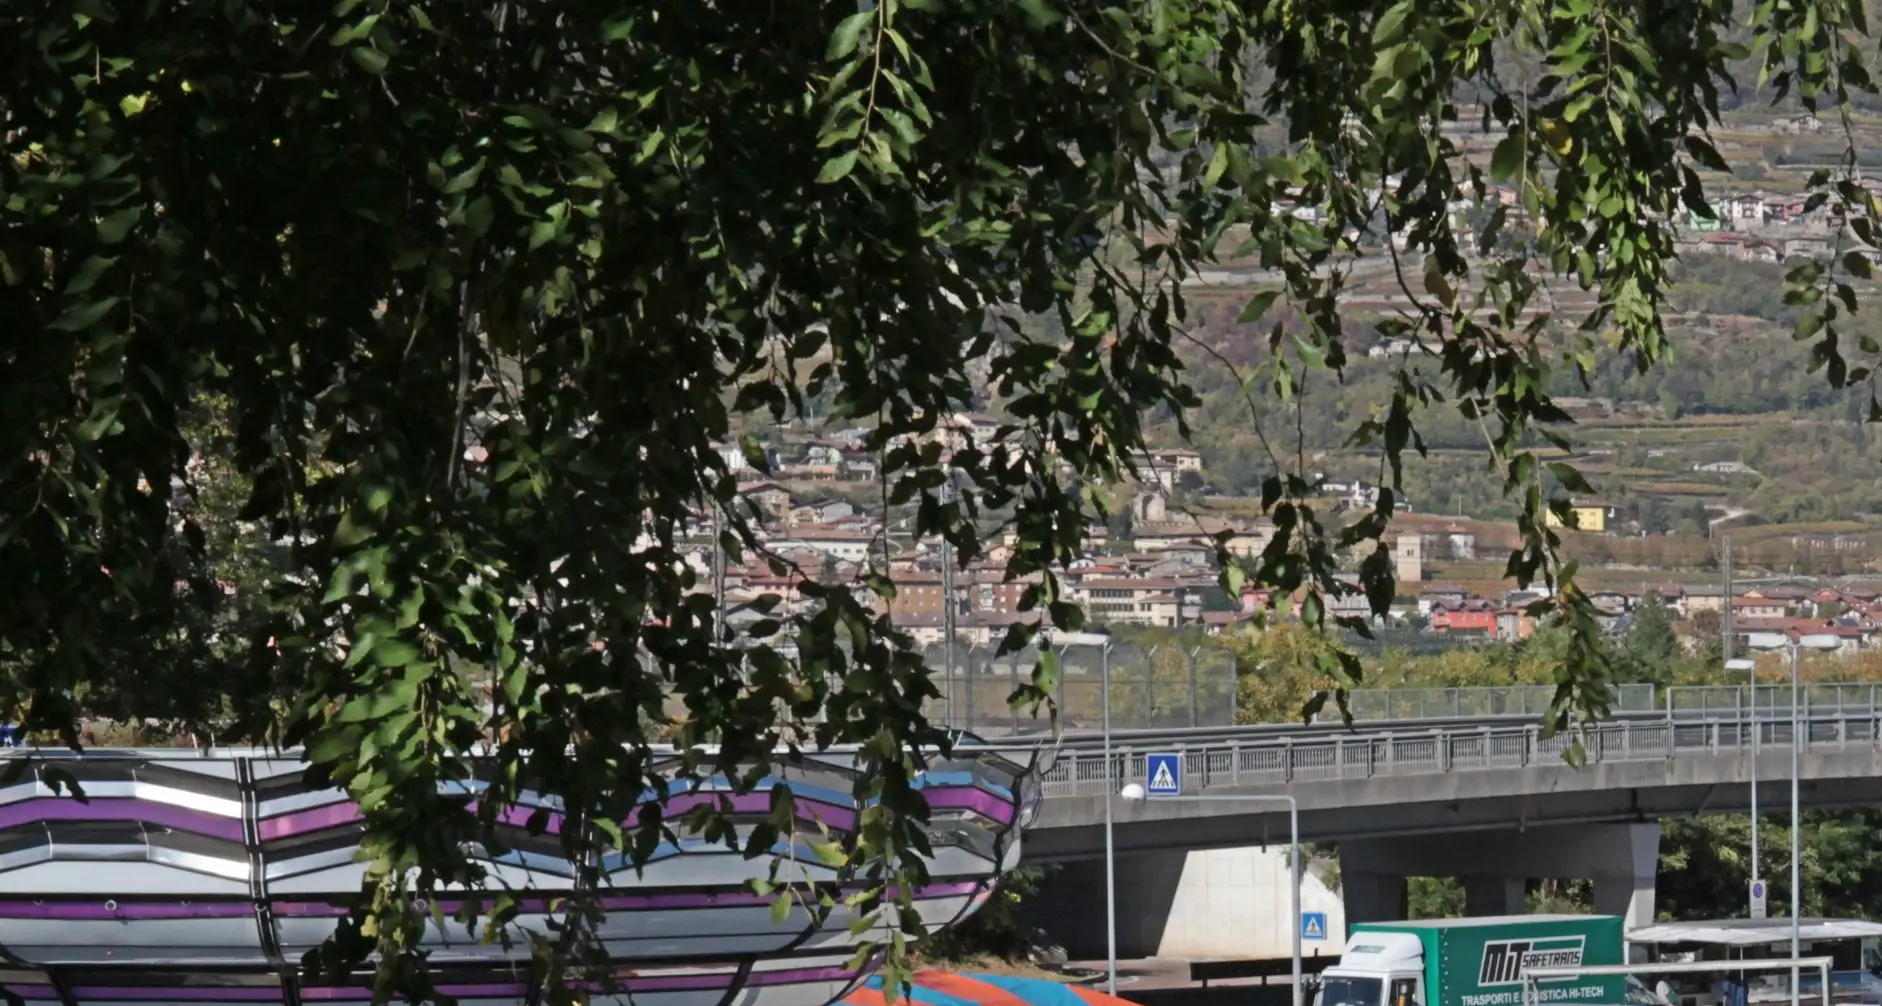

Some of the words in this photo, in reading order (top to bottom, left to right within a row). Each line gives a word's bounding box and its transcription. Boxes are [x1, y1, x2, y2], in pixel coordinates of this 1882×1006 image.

[1521, 951, 1580, 967] SAFETRANS
[1461, 994, 1512, 1006] TRASPORTI
[1513, 993, 1521, 1004] E
[1569, 987, 1604, 998] HI-TECH
